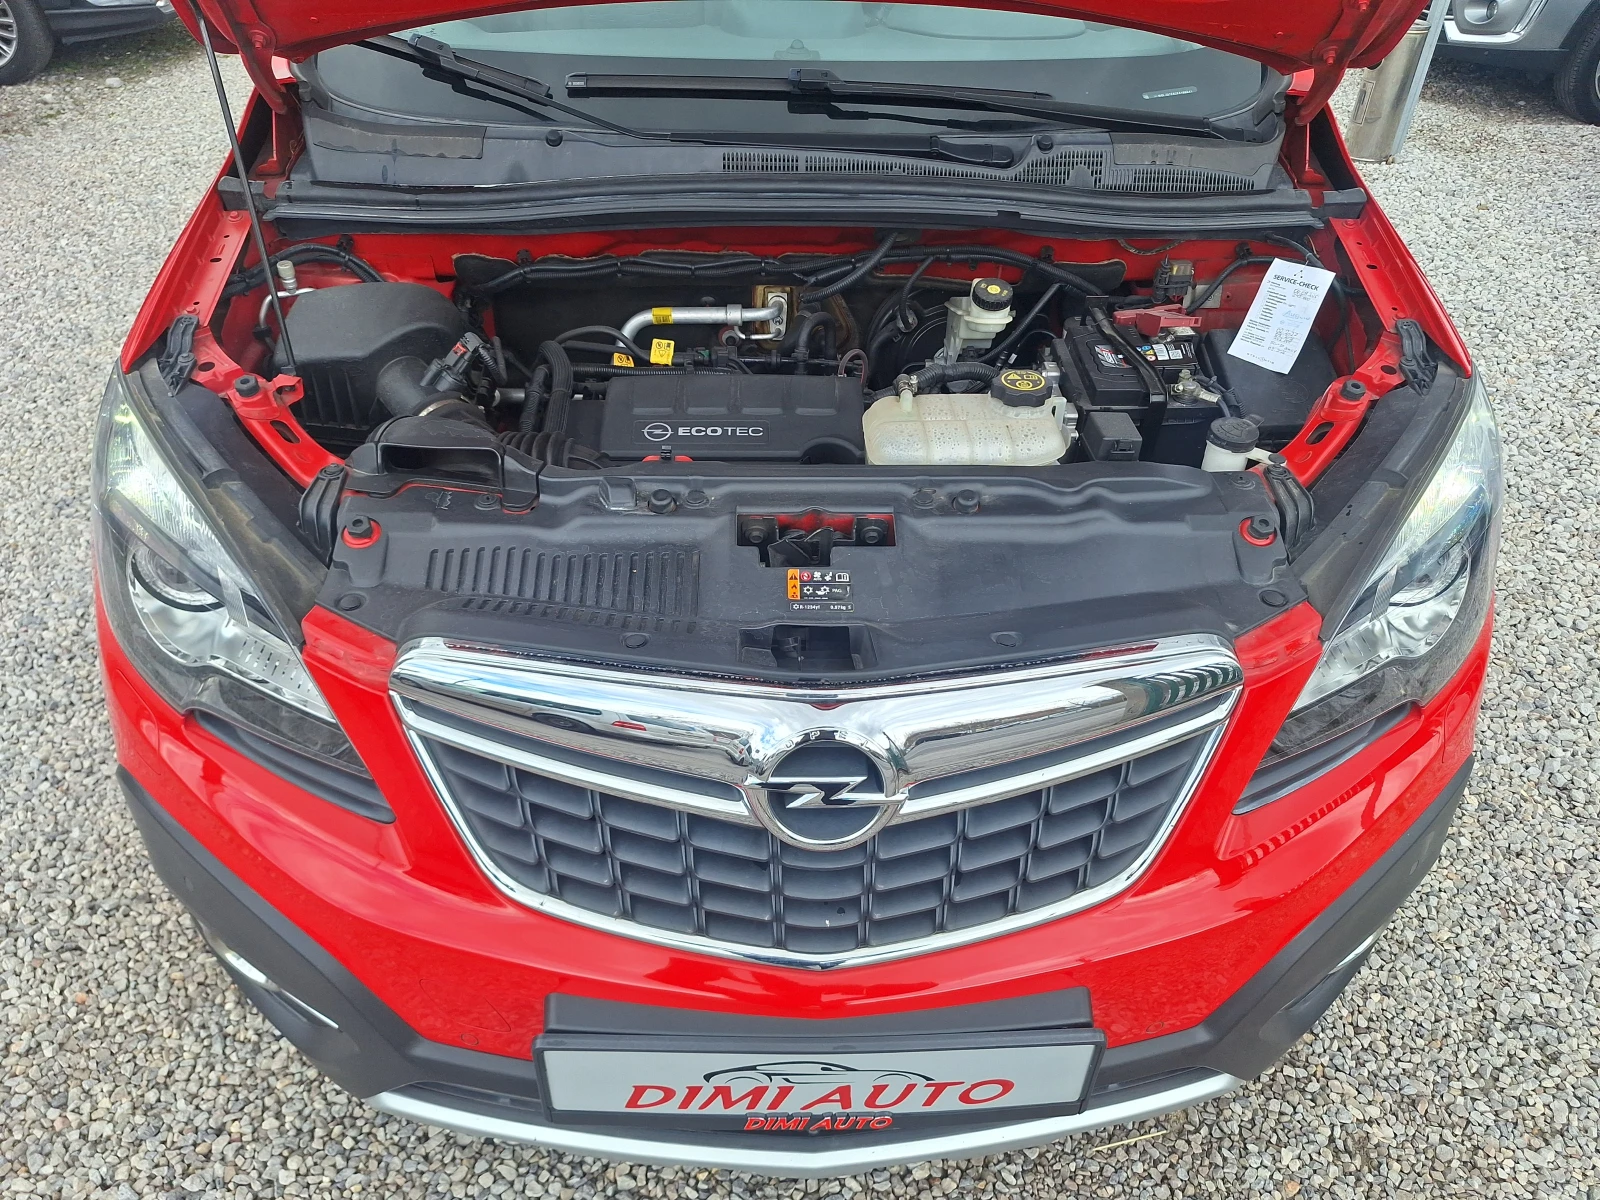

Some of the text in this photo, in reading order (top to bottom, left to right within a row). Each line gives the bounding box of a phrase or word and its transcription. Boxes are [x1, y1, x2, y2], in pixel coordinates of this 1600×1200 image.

[1273, 274, 1320, 291] SERVICE-CHECK
[678, 426, 763, 436] ECOTEC
[625, 1078, 1015, 1111] DIMI AUTO
[744, 1116, 893, 1131] DIMI AUTO
